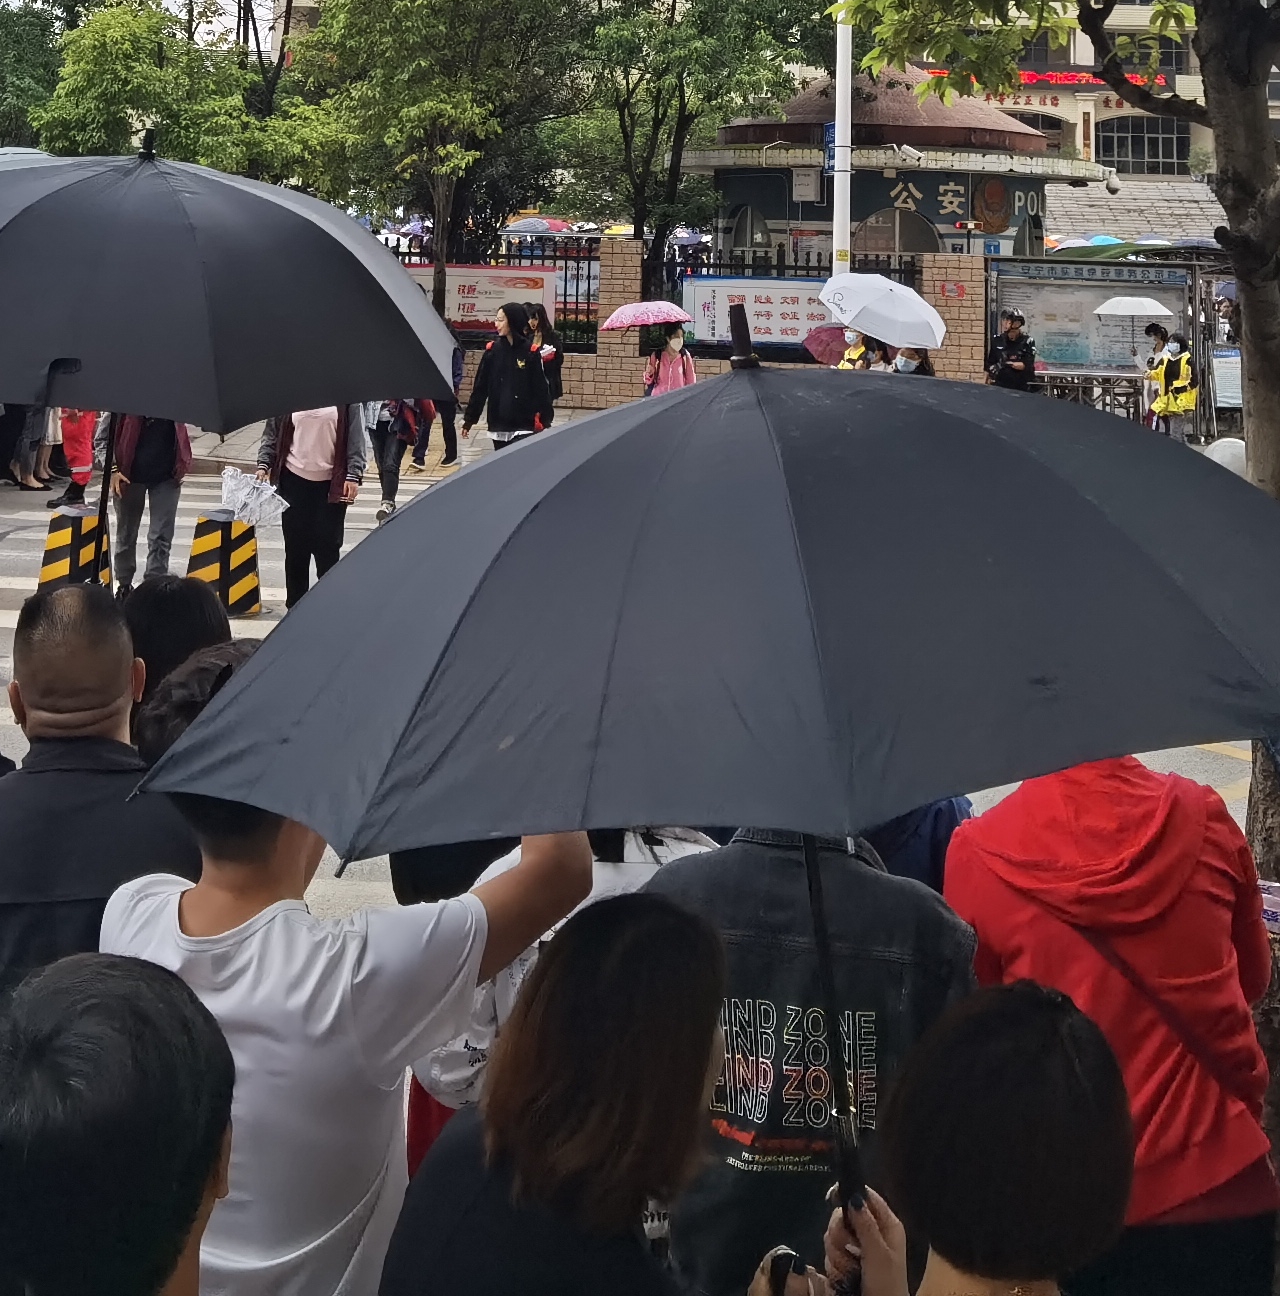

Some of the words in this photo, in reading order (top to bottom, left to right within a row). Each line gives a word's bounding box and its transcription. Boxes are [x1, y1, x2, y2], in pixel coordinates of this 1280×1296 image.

[889, 181, 966, 216] 公安
[783, 1066, 877, 1100] ZOE
[783, 1094, 876, 1129] ZOE
